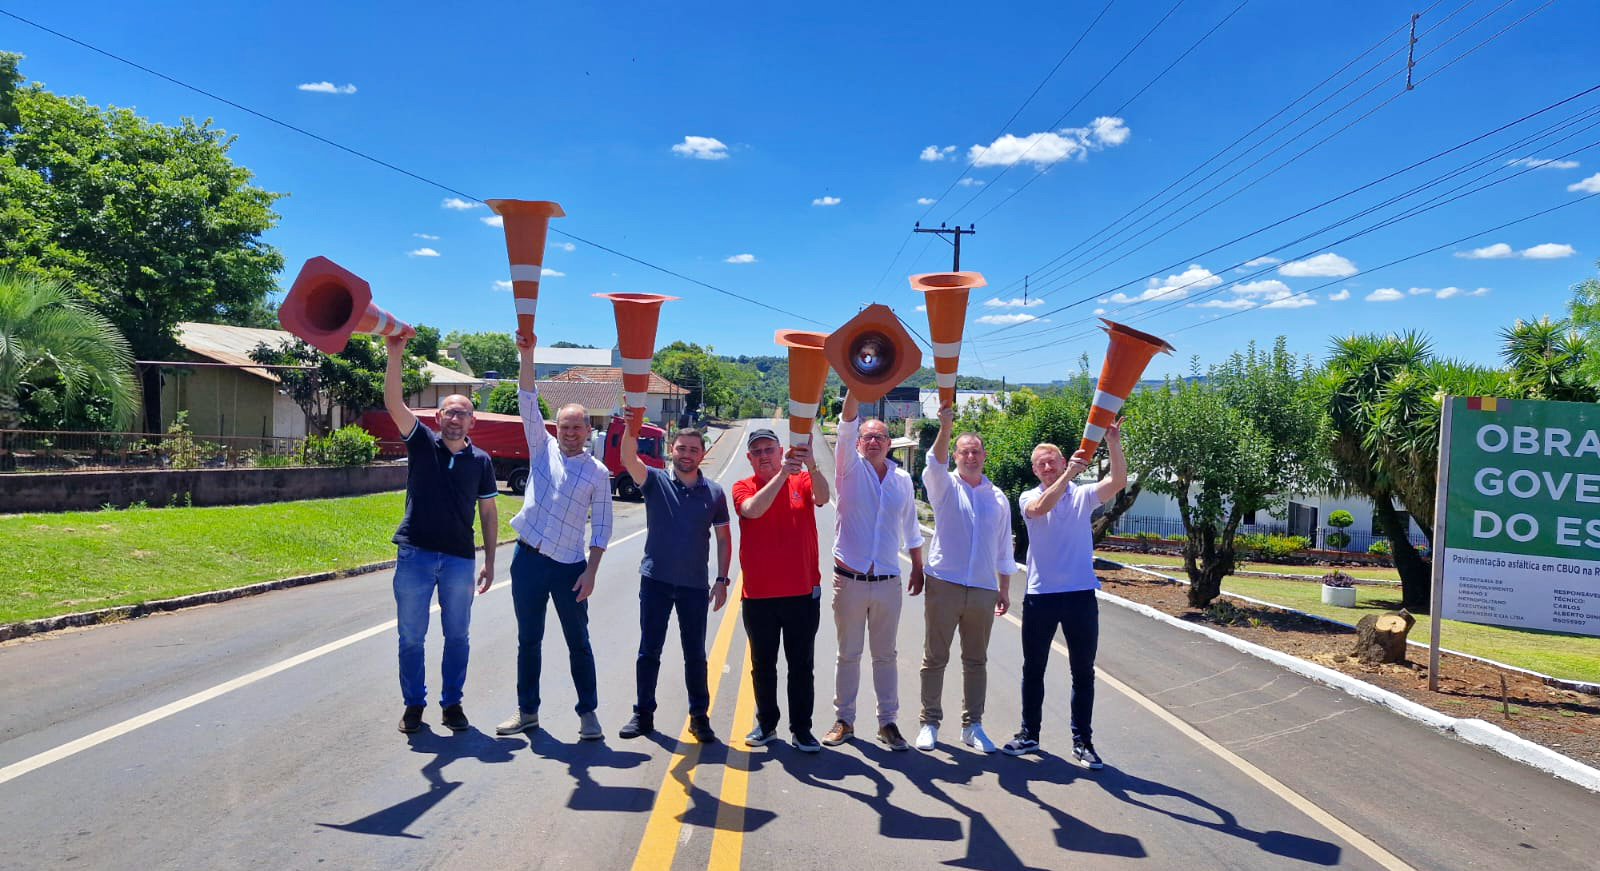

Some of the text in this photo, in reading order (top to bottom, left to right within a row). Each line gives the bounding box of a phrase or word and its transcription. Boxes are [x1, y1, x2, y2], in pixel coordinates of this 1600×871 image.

[1476, 424, 1600, 458] OBRA
[1474, 467, 1600, 503] GOVE
[1472, 510, 1539, 542] DO
[1453, 554, 1506, 568] Pavimentação
[1507, 559, 1540, 571] asfáltica
[1542, 564, 1555, 572] em
[1556, 563, 1581, 575] CBUQ
[1582, 567, 1593, 576] na
[1553, 603, 1581, 611] CARLOS
[1553, 610, 1585, 619] ALBERTO
